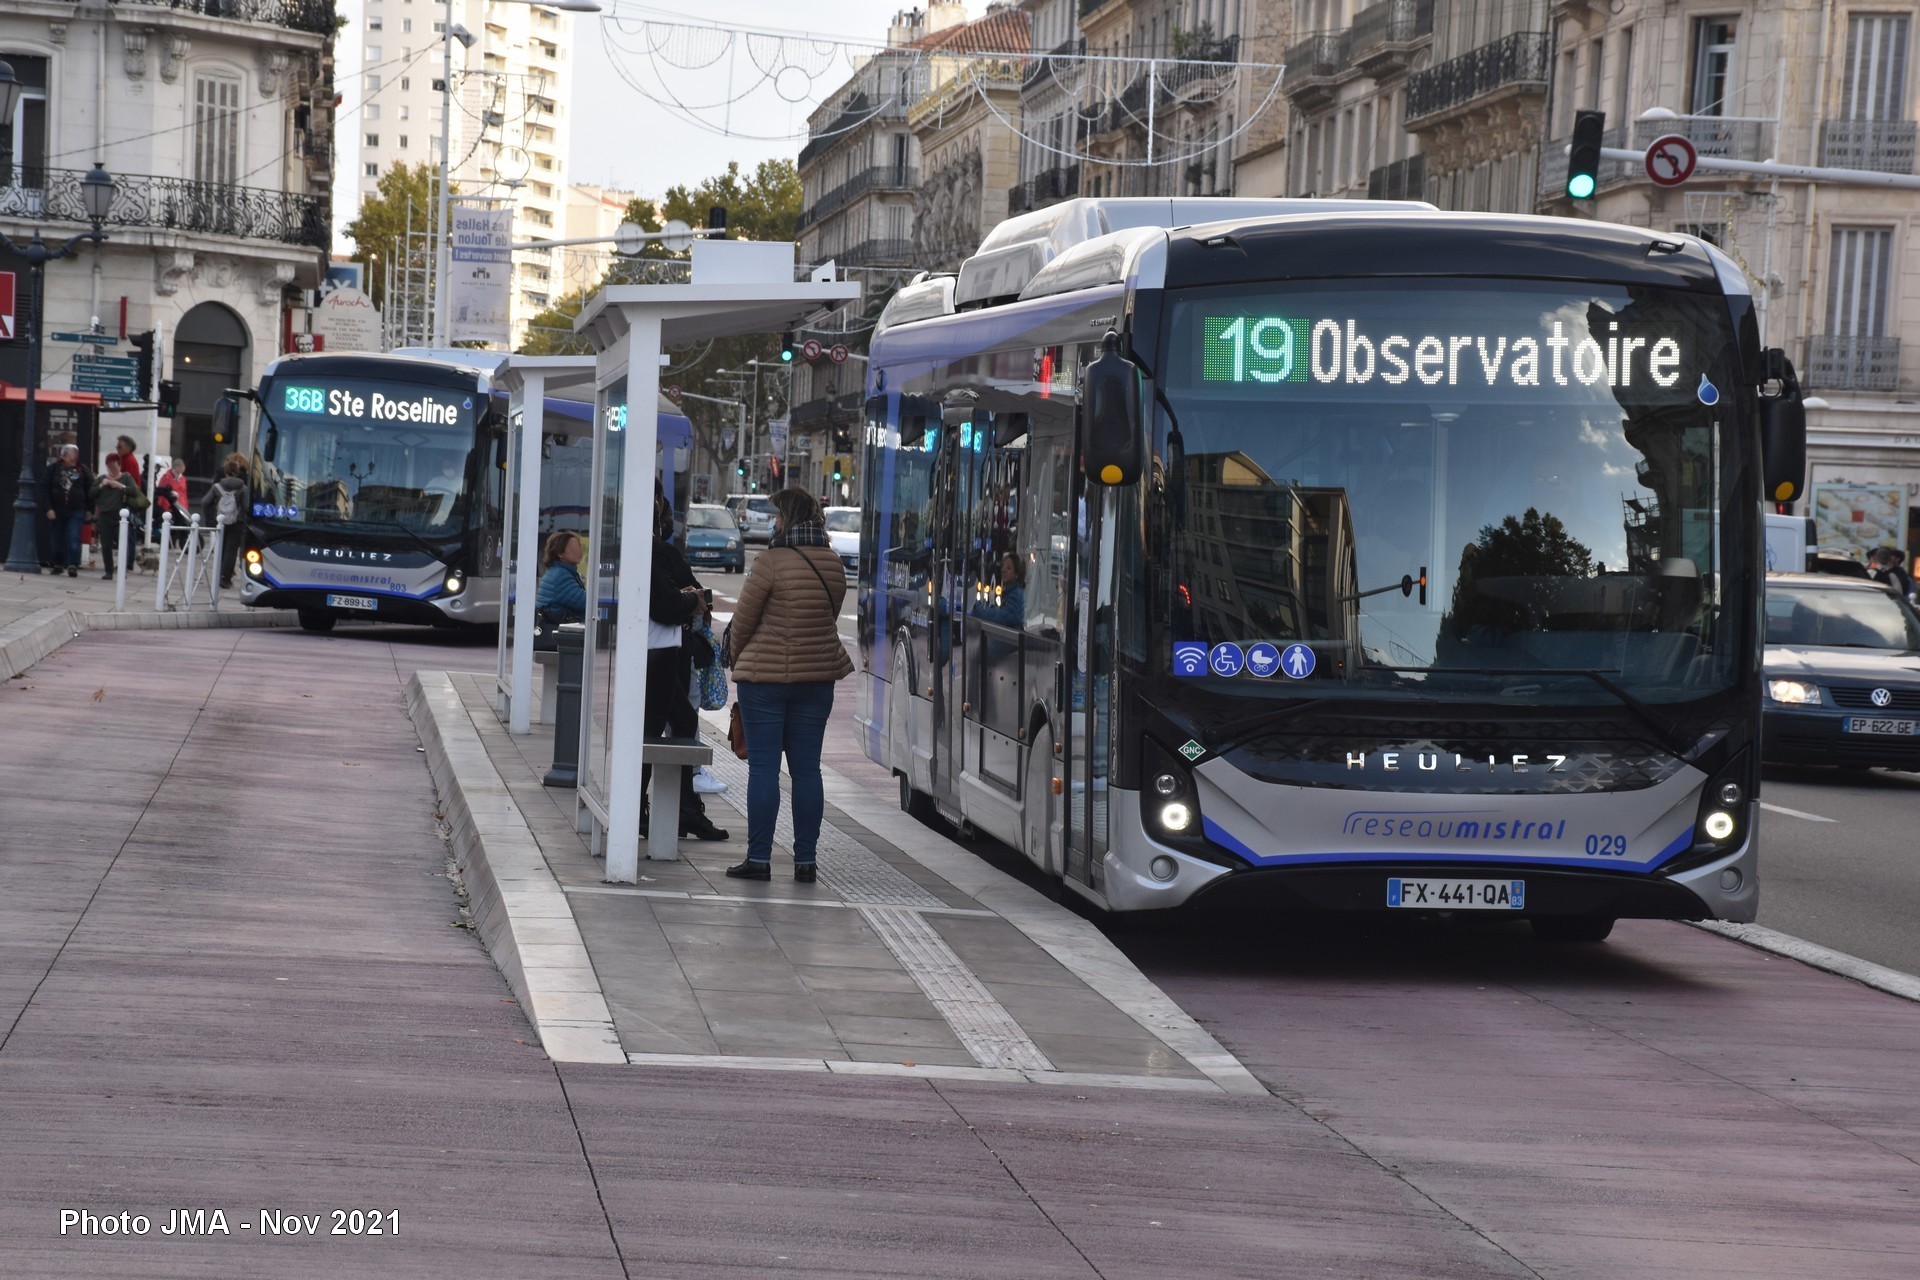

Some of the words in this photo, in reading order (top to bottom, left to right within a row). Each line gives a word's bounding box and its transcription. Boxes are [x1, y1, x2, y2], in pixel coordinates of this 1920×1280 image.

[1218, 316, 1294, 384] 19
[1311, 318, 1681, 386] Observatoire
[286, 387, 324, 412] 36B
[329, 389, 364, 417] Ste
[371, 392, 458, 425] Roseline
[310, 547, 392, 561] HEULIEZ
[390, 582, 407, 592] 803
[1183, 746, 1201, 755] GNC
[1346, 752, 1567, 773] HEULIEZ
[1584, 834, 1626, 857] 029
[1401, 882, 1510, 905] FX-441-QA
[1511, 896, 1523, 906] 83
